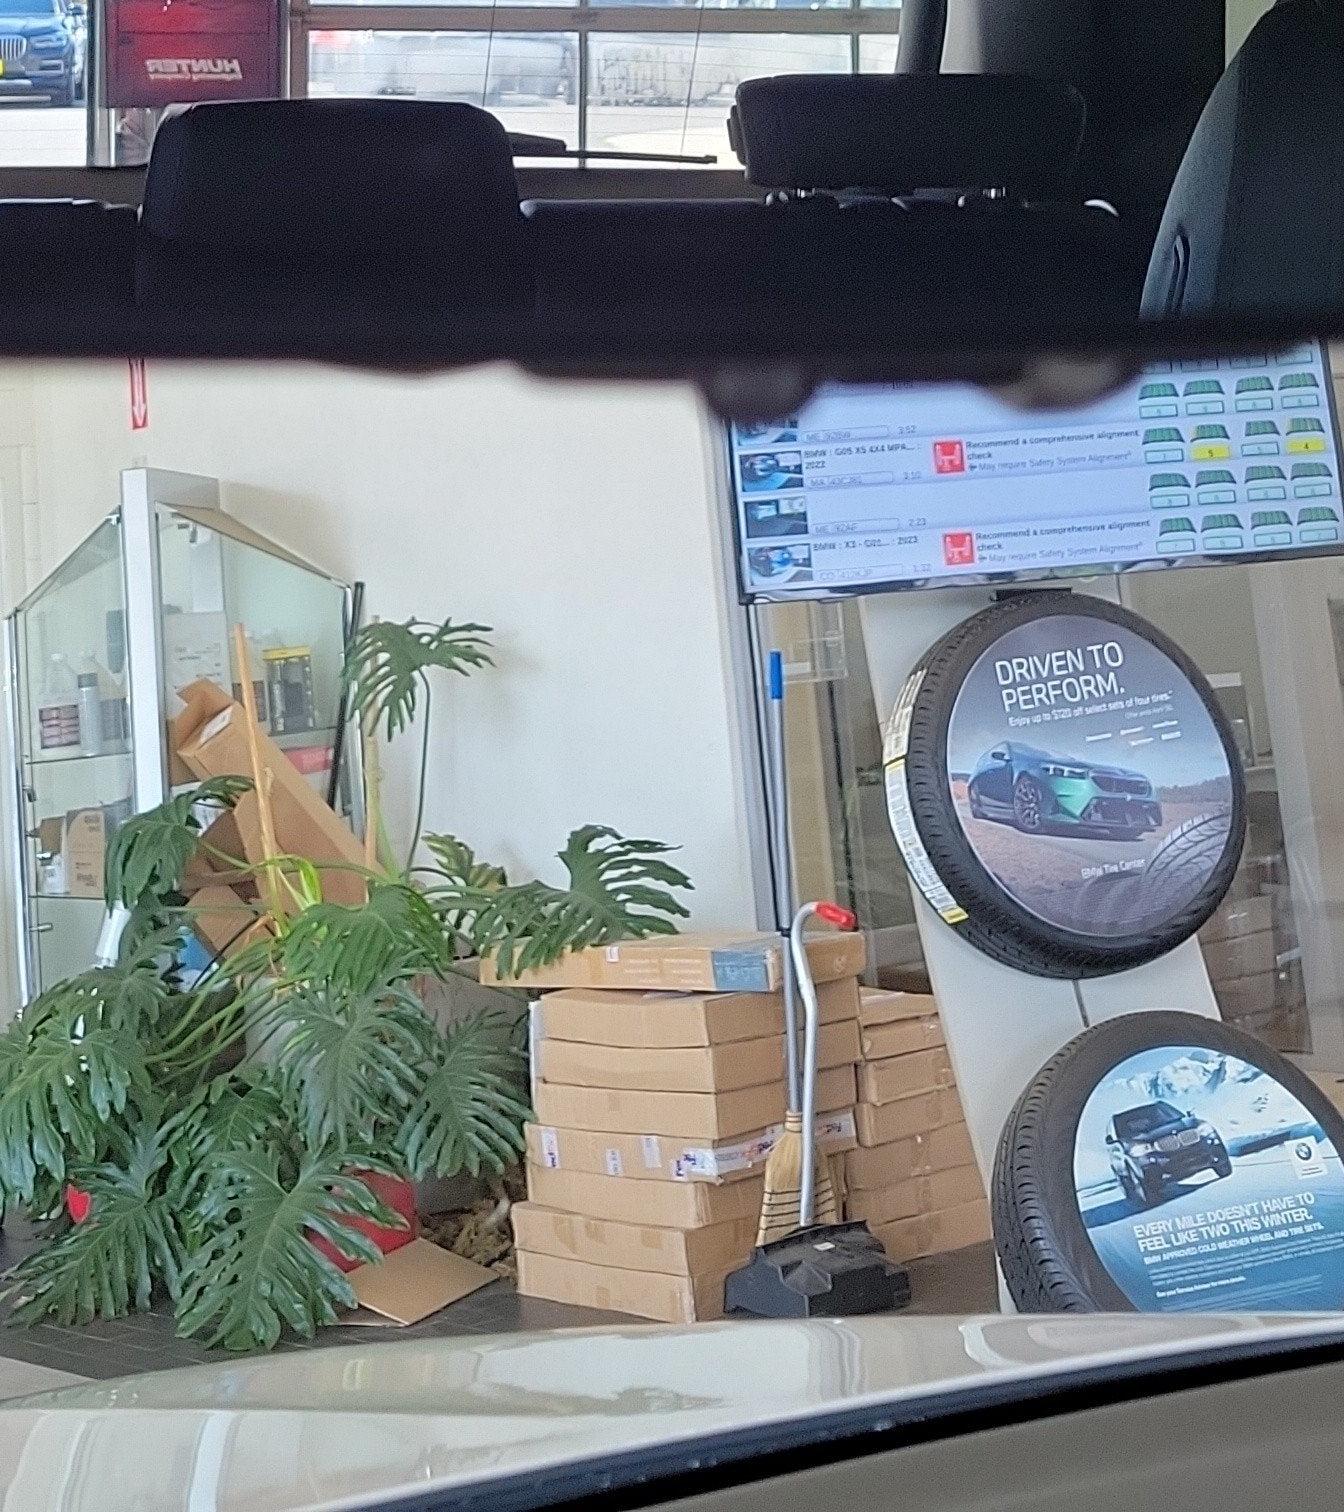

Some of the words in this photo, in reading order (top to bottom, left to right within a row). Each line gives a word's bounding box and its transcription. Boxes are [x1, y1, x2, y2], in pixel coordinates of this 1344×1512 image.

[966, 438, 1019, 449] Recommend
[1097, 430, 1139, 440] alignment
[967, 452, 992, 460] check
[976, 529, 1030, 540] Recommend
[1108, 519, 1150, 530] alignment
[977, 542, 1002, 551] check
[1039, 549, 1065, 559] Safety
[1067, 546, 1098, 557] System
[995, 648, 1085, 685] DRIVEN
[1086, 641, 1124, 670] TO
[1001, 672, 1125, 713] PERFORM.
[1008, 715, 1030, 727] Enjoy
[1031, 714, 1042, 724] up
[1042, 712, 1051, 722] to
[1072, 705, 1084, 717] off
[1084, 703, 1108, 716] select
[1108, 700, 1125, 711] sets
[1125, 697, 1134, 708] of
[1135, 695, 1150, 706] four
[1133, 1219, 1173, 1239] EVERY
[1175, 1213, 1205, 1231] MILE
[1206, 1203, 1259, 1223] DOESN'T
[1261, 1196, 1296, 1213] HAVE
[1297, 1191, 1315, 1206] TO
[1137, 1236, 1171, 1253] FEEL
[1171, 1230, 1200, 1247] LIKE
[1199, 1223, 1230, 1239] TWO
[1230, 1216, 1260, 1235] THIS
[1260, 1207, 1313, 1229] WINTER.
[1162, 1246, 1198, 1262] APPROVED
[1198, 1242, 1217, 1253] COLD
[1217, 1236, 1250, 1250] WEATHER
[1249, 1231, 1274, 1244] WHEEL
[1274, 1229, 1289, 1239] AND
[1289, 1225, 1308, 1237] TIRE
